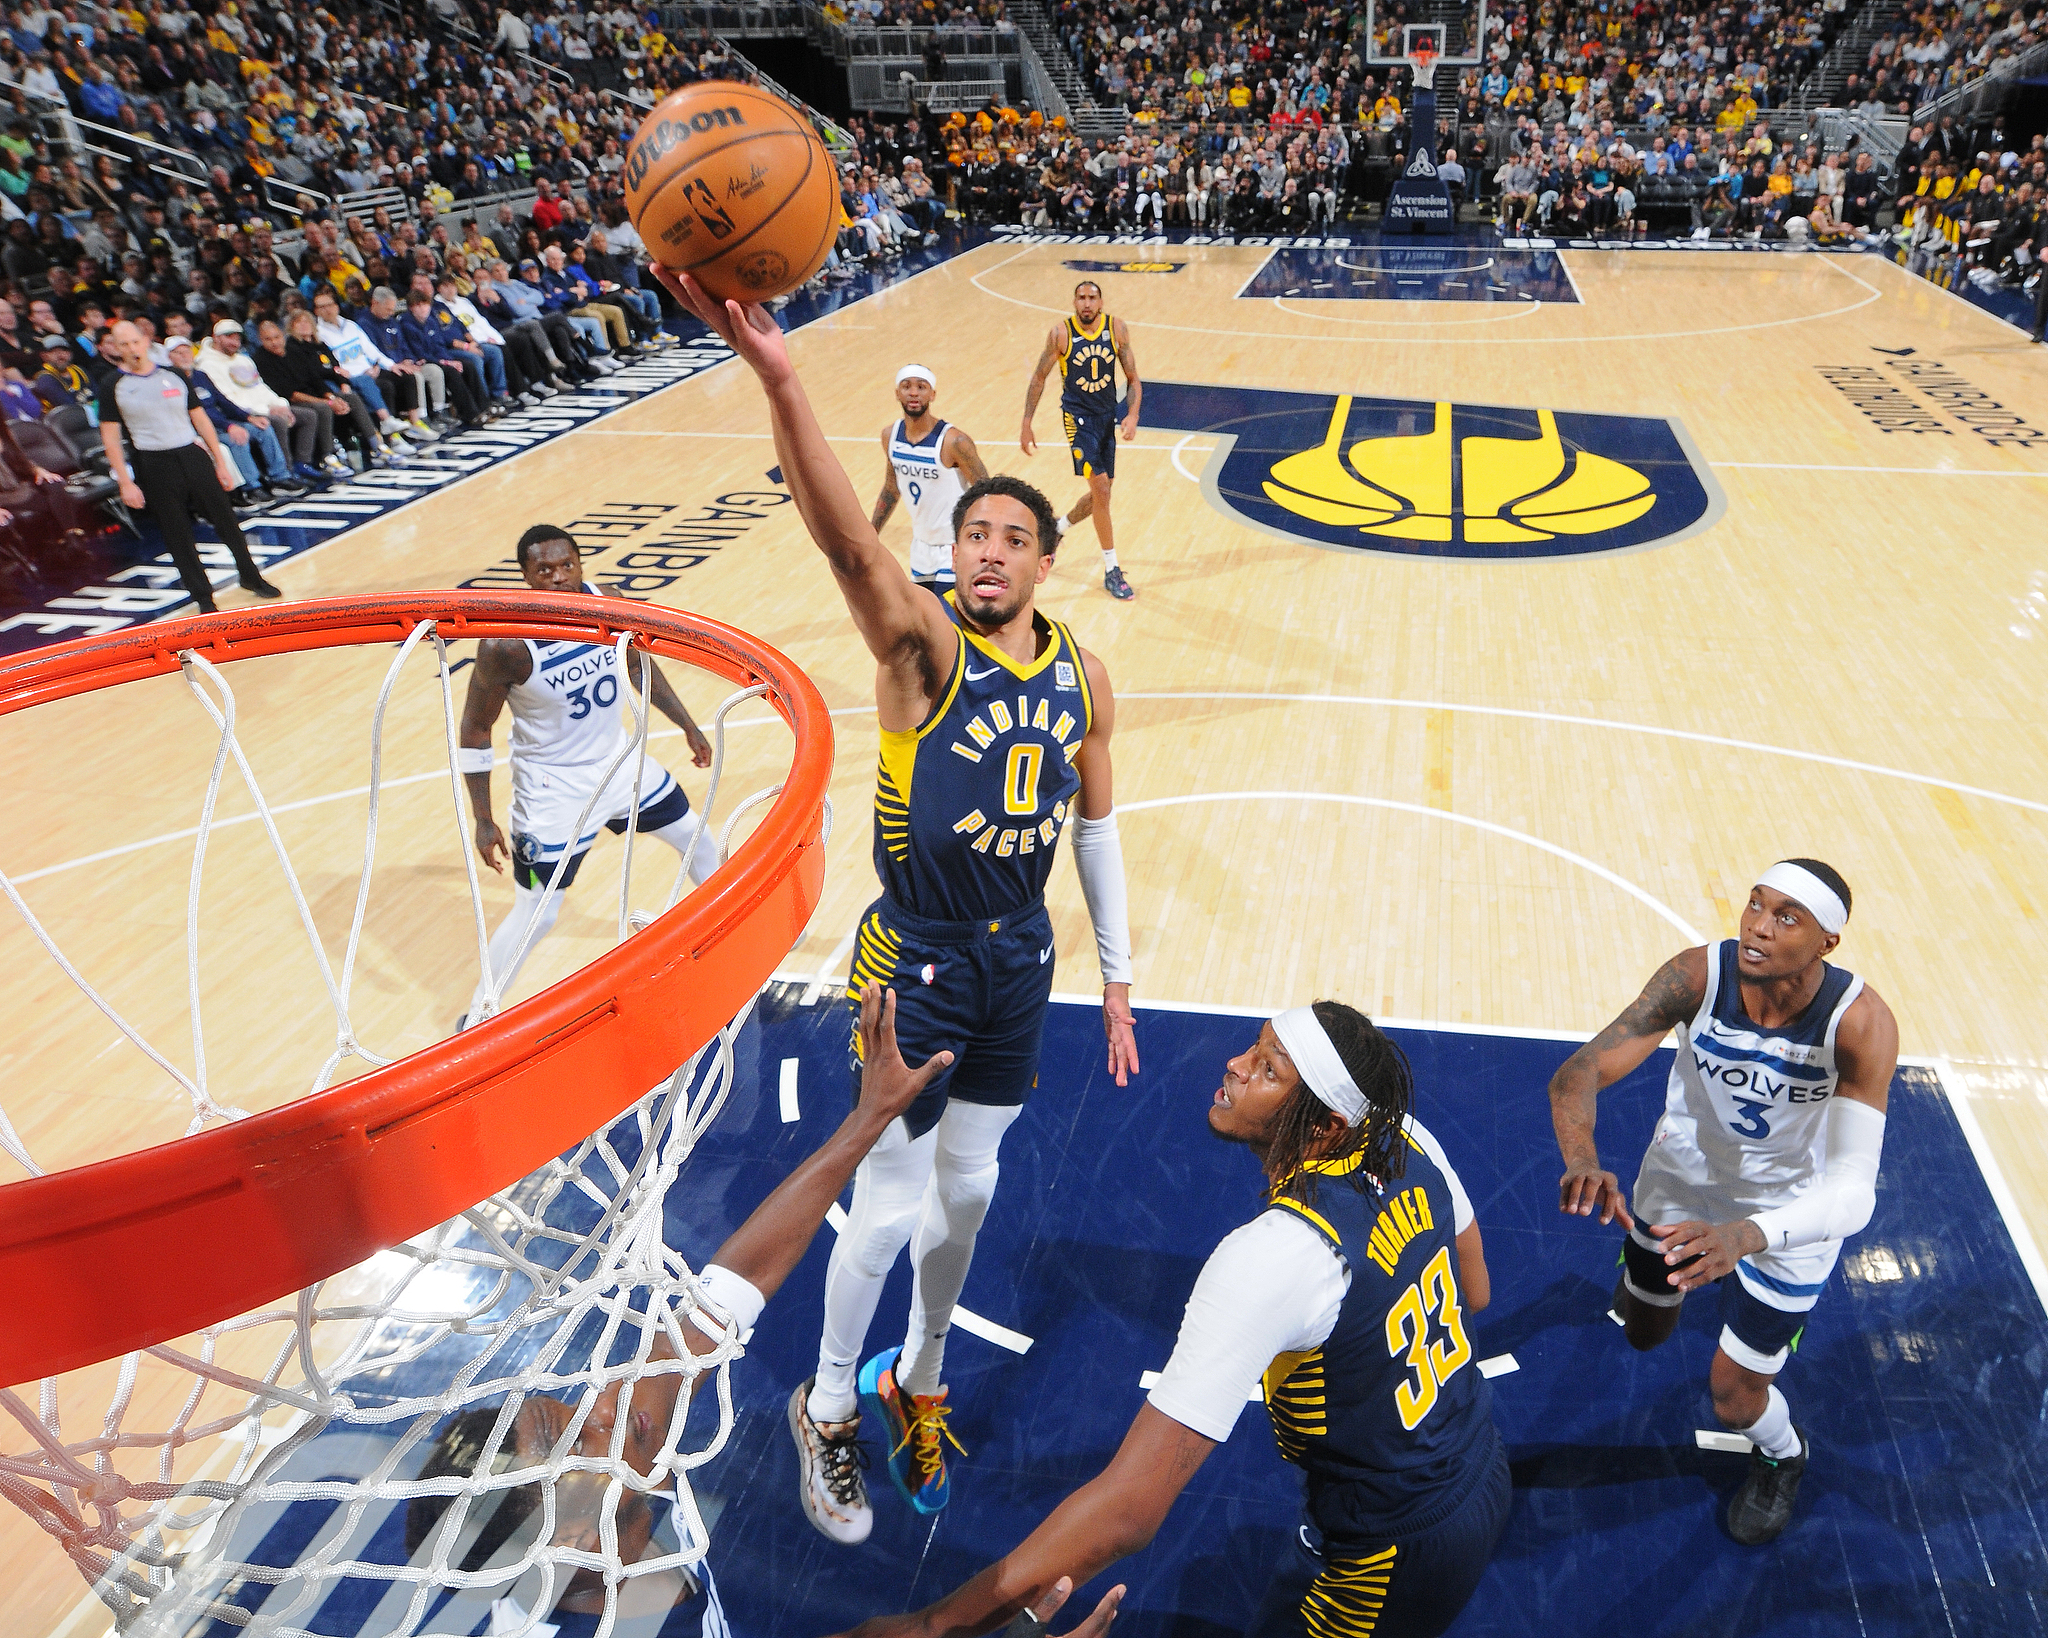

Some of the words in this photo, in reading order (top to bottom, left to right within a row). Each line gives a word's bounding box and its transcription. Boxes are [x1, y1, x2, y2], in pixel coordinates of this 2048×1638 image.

[626, 105, 748, 192] Wilson
[1390, 207, 1406, 218] St.
[1407, 206, 1449, 218] Vincent
[1392, 194, 1448, 206] Ascension
[991, 234, 1168, 245] INDIANA
[1183, 236, 1351, 248] PACERS
[580, 348, 735, 392] GROW
[1072, 344, 1115, 367] INDIANA
[1091, 357, 1099, 380] 1
[1075, 373, 1112, 394] PACERS
[1813, 365, 1954, 436] FIELDHOUSE
[1885, 359, 2048, 447] GAINBRIDGE
[239, 394, 630, 531] BASKETBALL
[894, 463, 939, 480] WOLVES
[908, 481, 922, 506] 9
[595, 491, 793, 601] GAINBR
[566, 674, 618, 720] 30
[950, 695, 1082, 764] INDIANA
[1004, 743, 1045, 816] 0
[952, 800, 1067, 857] PACERS
[1692, 1051, 1829, 1104] WOLVES
[1784, 1049, 1817, 1061] sezzle
[1729, 1095, 1774, 1140] 3
[1366, 1186, 1434, 1277] TURNER
[1385, 1245, 1472, 1430] 33
